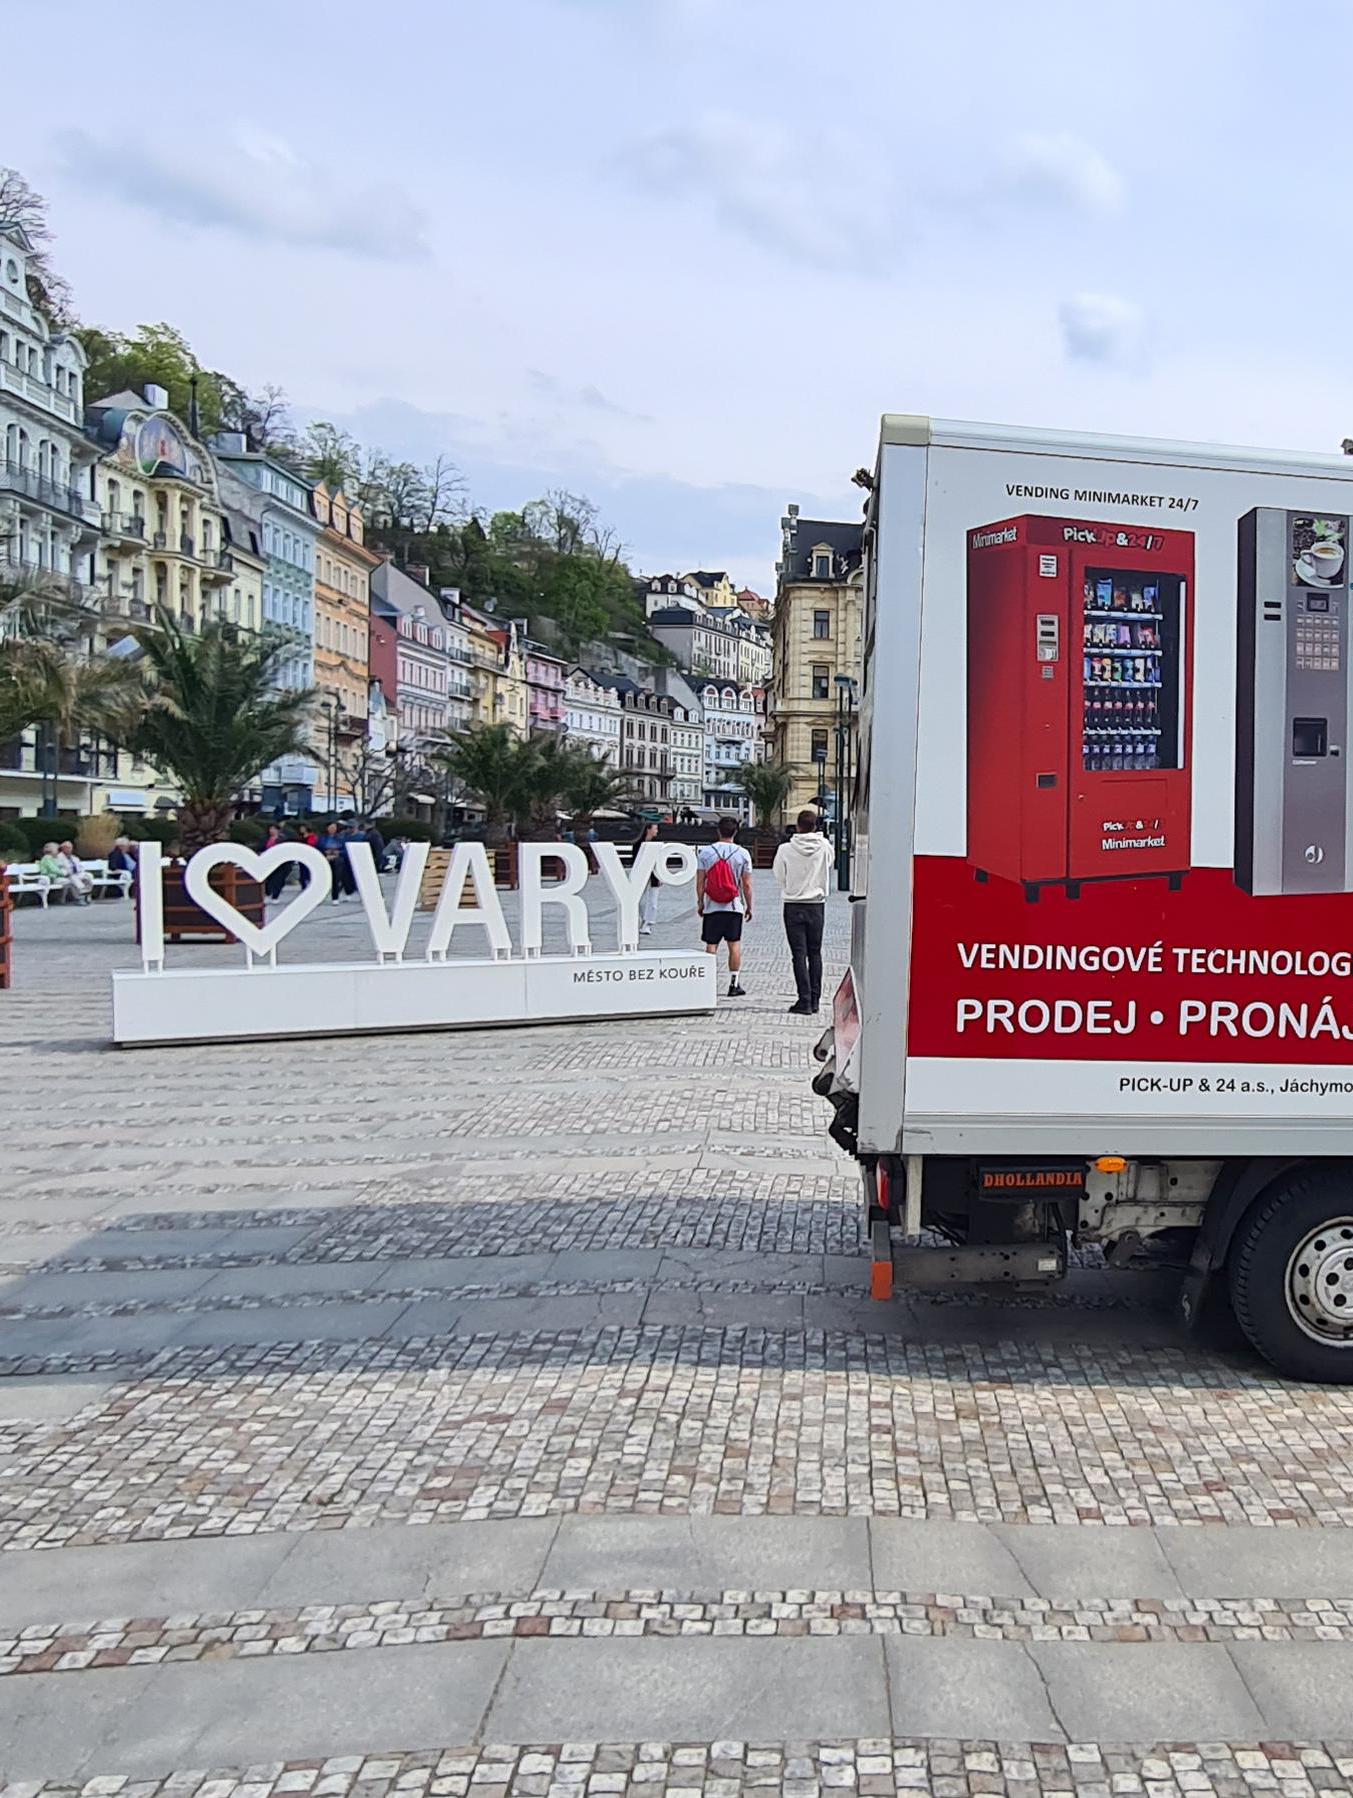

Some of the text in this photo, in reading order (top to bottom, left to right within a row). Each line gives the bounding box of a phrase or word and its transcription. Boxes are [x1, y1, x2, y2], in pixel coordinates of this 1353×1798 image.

[1006, 484, 1199, 513] VENDING MINIMARKET 24/7
[972, 526, 1018, 550] Minimarket
[1102, 835, 1166, 850] Minimarket
[957, 941, 1163, 973] VENDINGOVÉ
[573, 965, 706, 983] MĚSTO BEZ KOUŘE
[956, 999, 1137, 1034] PRODEJ
[1119, 1078, 1193, 1092] PICK-UP
[1199, 1078, 1211, 1092] &
[1216, 1079, 1236, 1092] 24
[1241, 1080, 1275, 1095] a.s.,
[983, 1171, 1083, 1187] DHOLLANDIA
